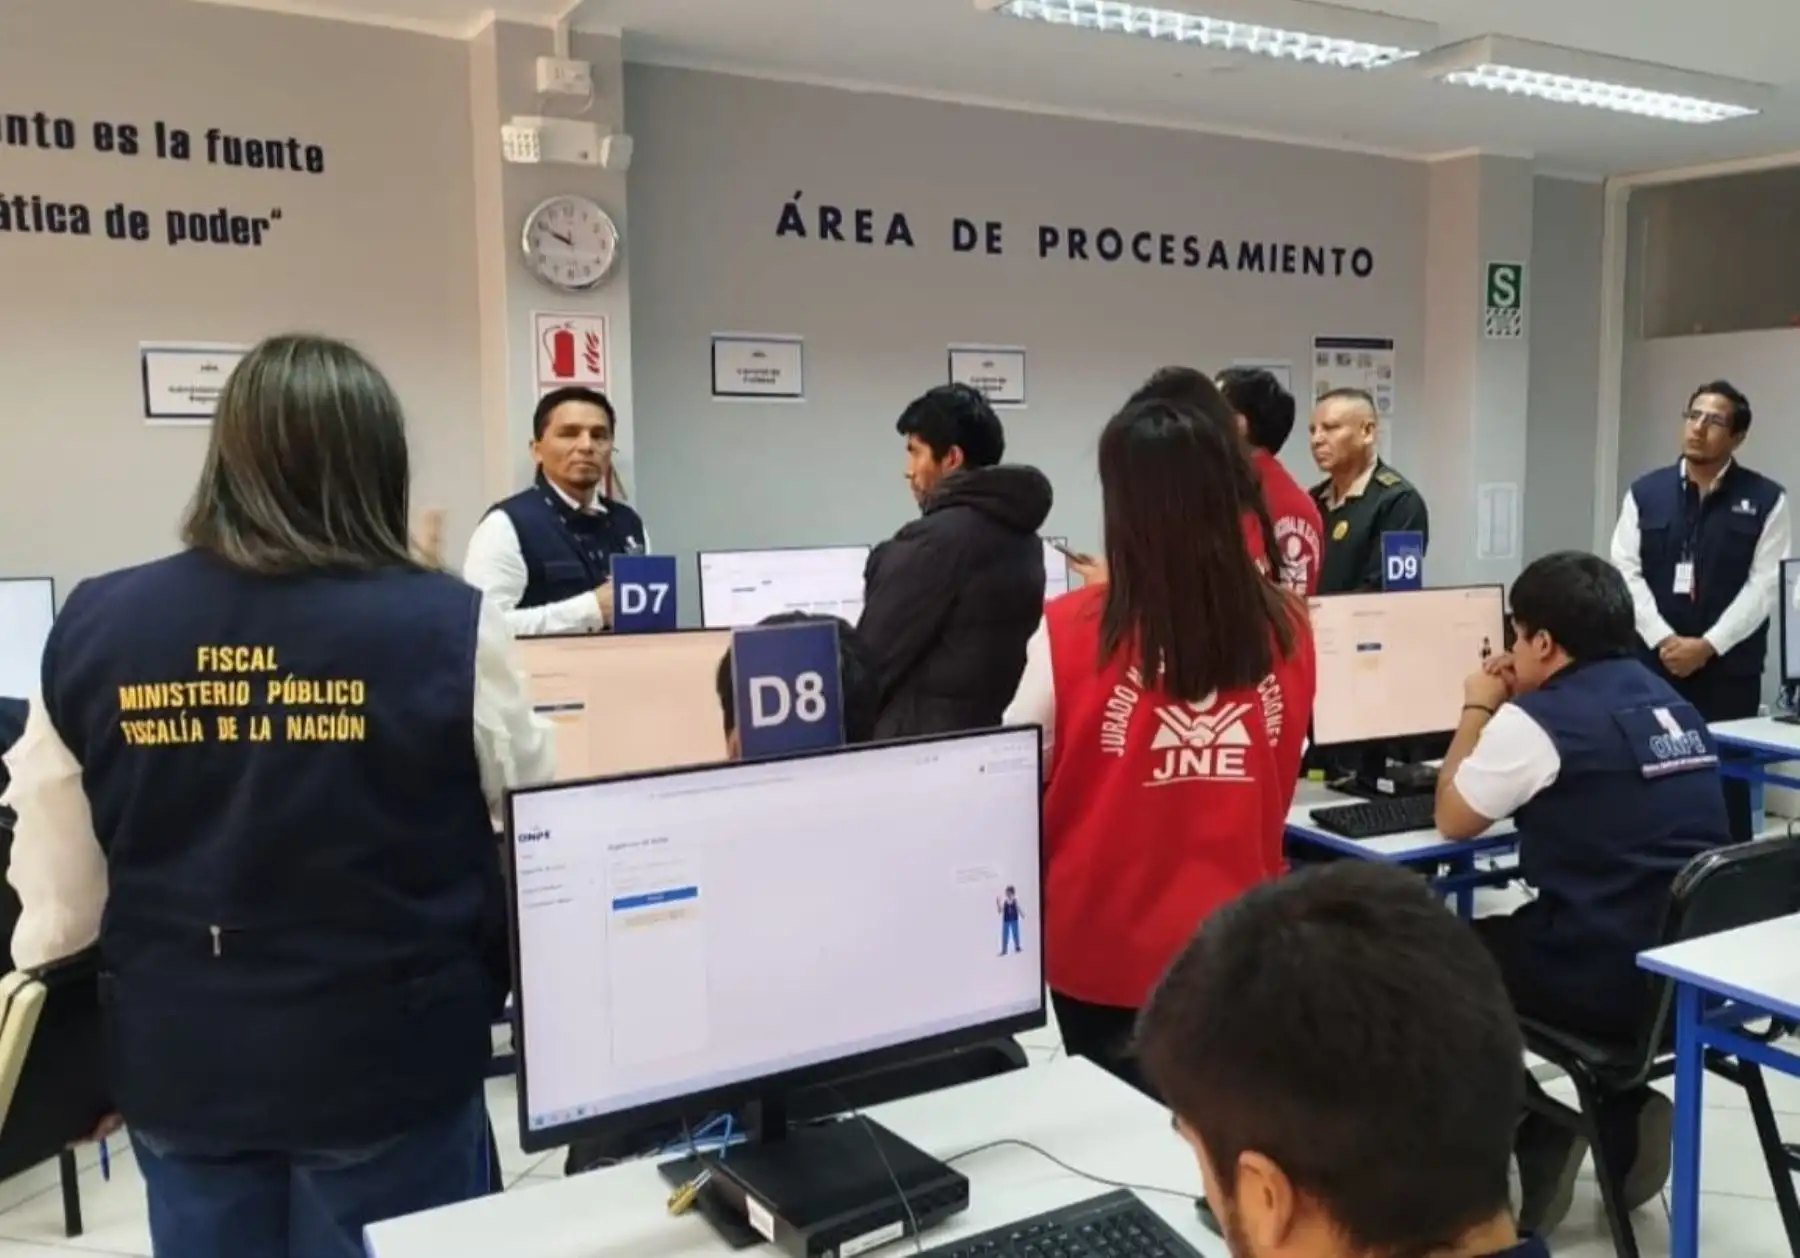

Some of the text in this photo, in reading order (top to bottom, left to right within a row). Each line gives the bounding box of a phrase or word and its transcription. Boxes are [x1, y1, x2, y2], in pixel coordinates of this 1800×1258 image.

[0, 111, 325, 173] nto es la fuente
[105, 203, 150, 241] de
[776, 190, 1374, 278] ÁREA DE PROCESAMIENTO
[1493, 266, 1515, 307] S
[1387, 555, 1418, 581] D9
[620, 583, 669, 615] D7
[197, 646, 279, 673] FISCAL
[119, 673, 365, 711] MINISTERIO PÚBLICO
[749, 671, 826, 729] D8
[120, 708, 365, 745] FISCALÍA DE LA NACIÓN
[1100, 684, 1139, 758] JURADO
[1153, 747, 1246, 780] JNE
